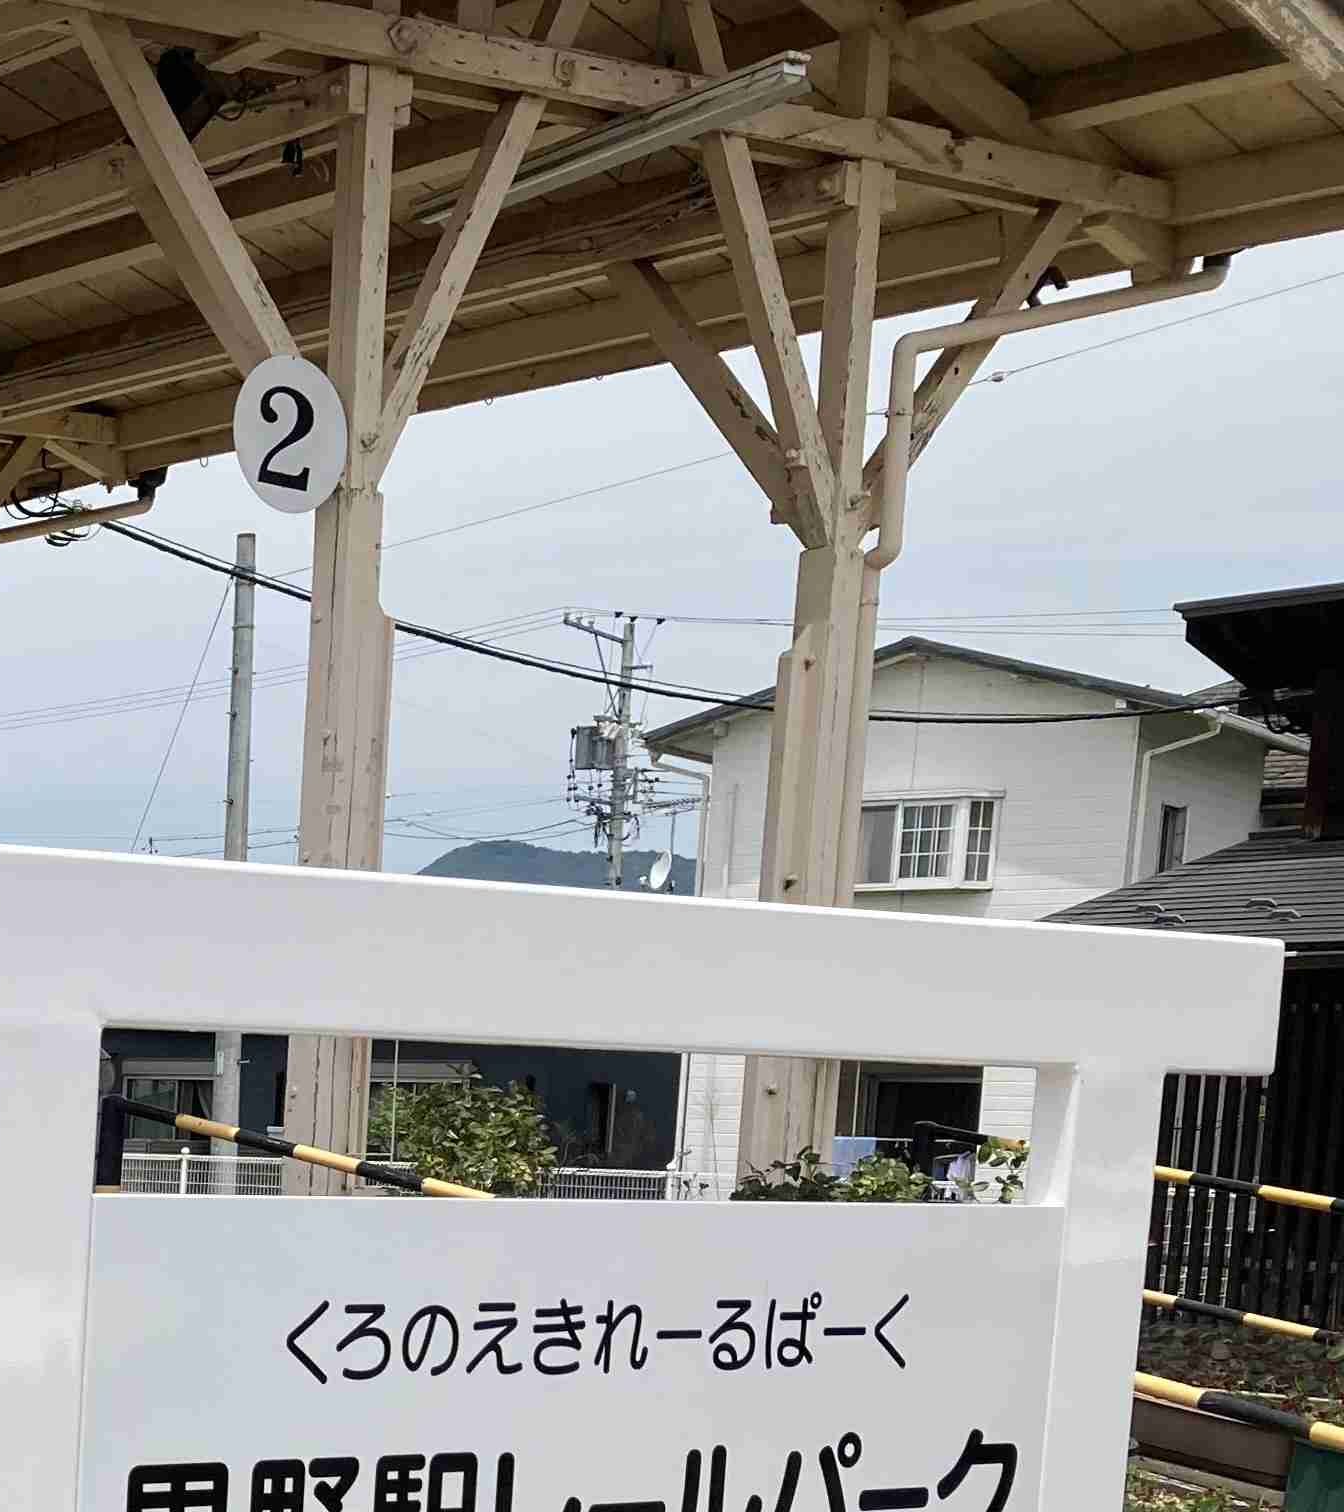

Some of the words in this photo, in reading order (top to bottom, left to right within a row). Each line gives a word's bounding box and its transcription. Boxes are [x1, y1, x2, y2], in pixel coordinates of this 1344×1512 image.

[257, 385, 315, 492] 2
[286, 1291, 910, 1385] くろのえきれーるぱーく
